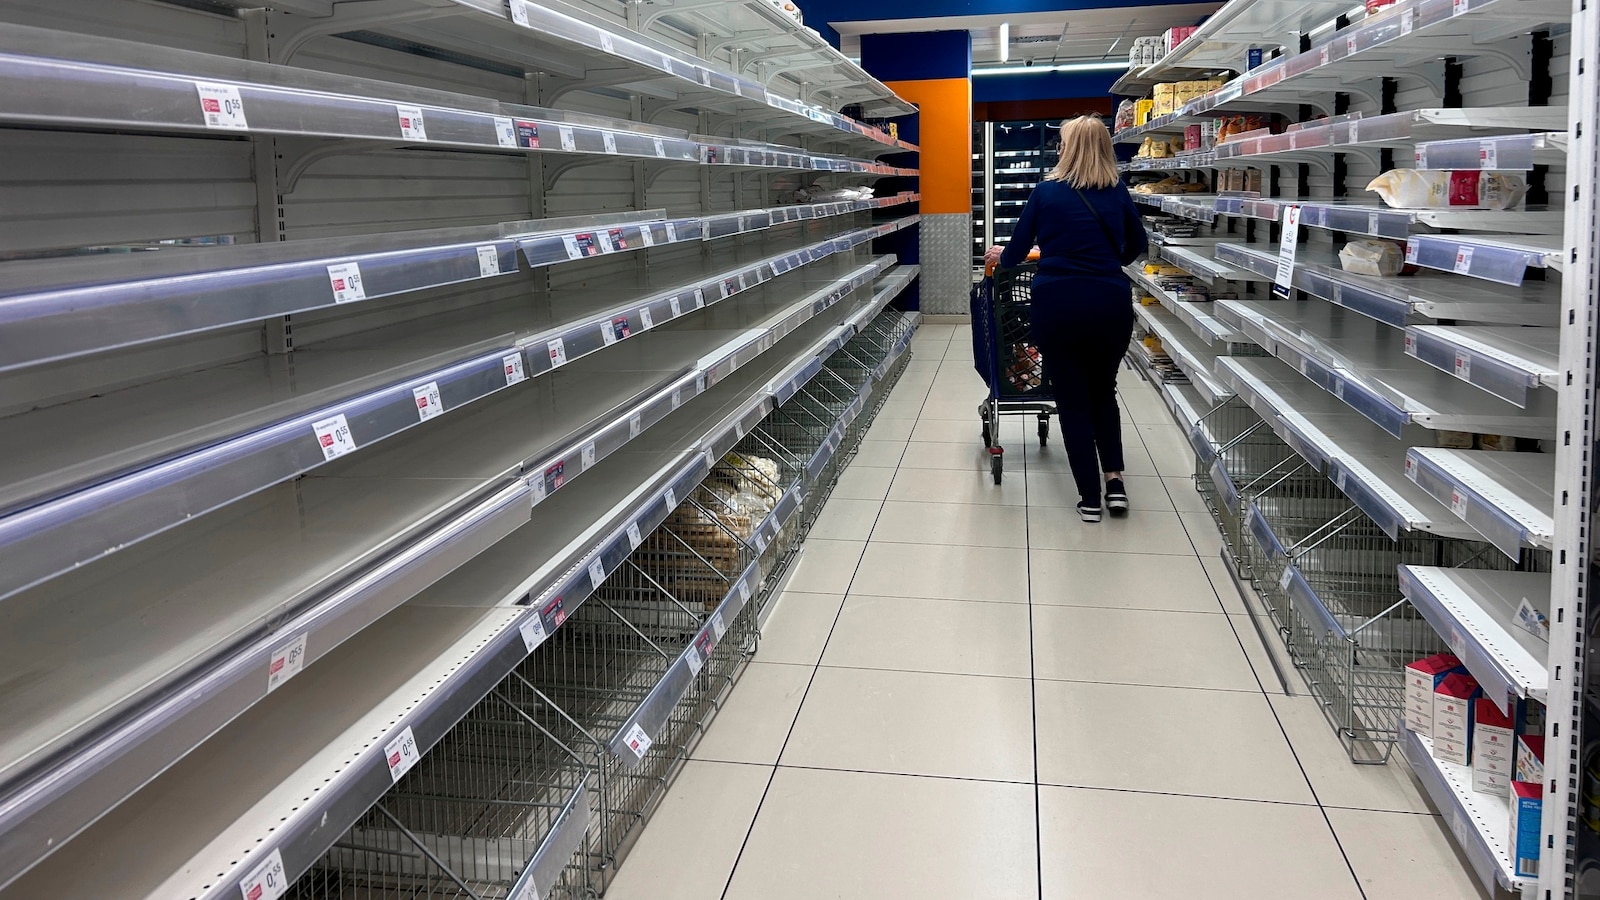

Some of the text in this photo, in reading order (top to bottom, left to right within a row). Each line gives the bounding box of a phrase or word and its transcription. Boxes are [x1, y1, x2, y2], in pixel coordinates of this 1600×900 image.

[225, 98, 241, 118] 0,55
[348, 274, 361, 292] 0,55
[429, 390, 439, 407] 0,55
[335, 425, 349, 444] 0,55
[289, 643, 303, 665] 0,55
[402, 737, 414, 756] 0,55
[266, 862, 282, 889] 0,55
